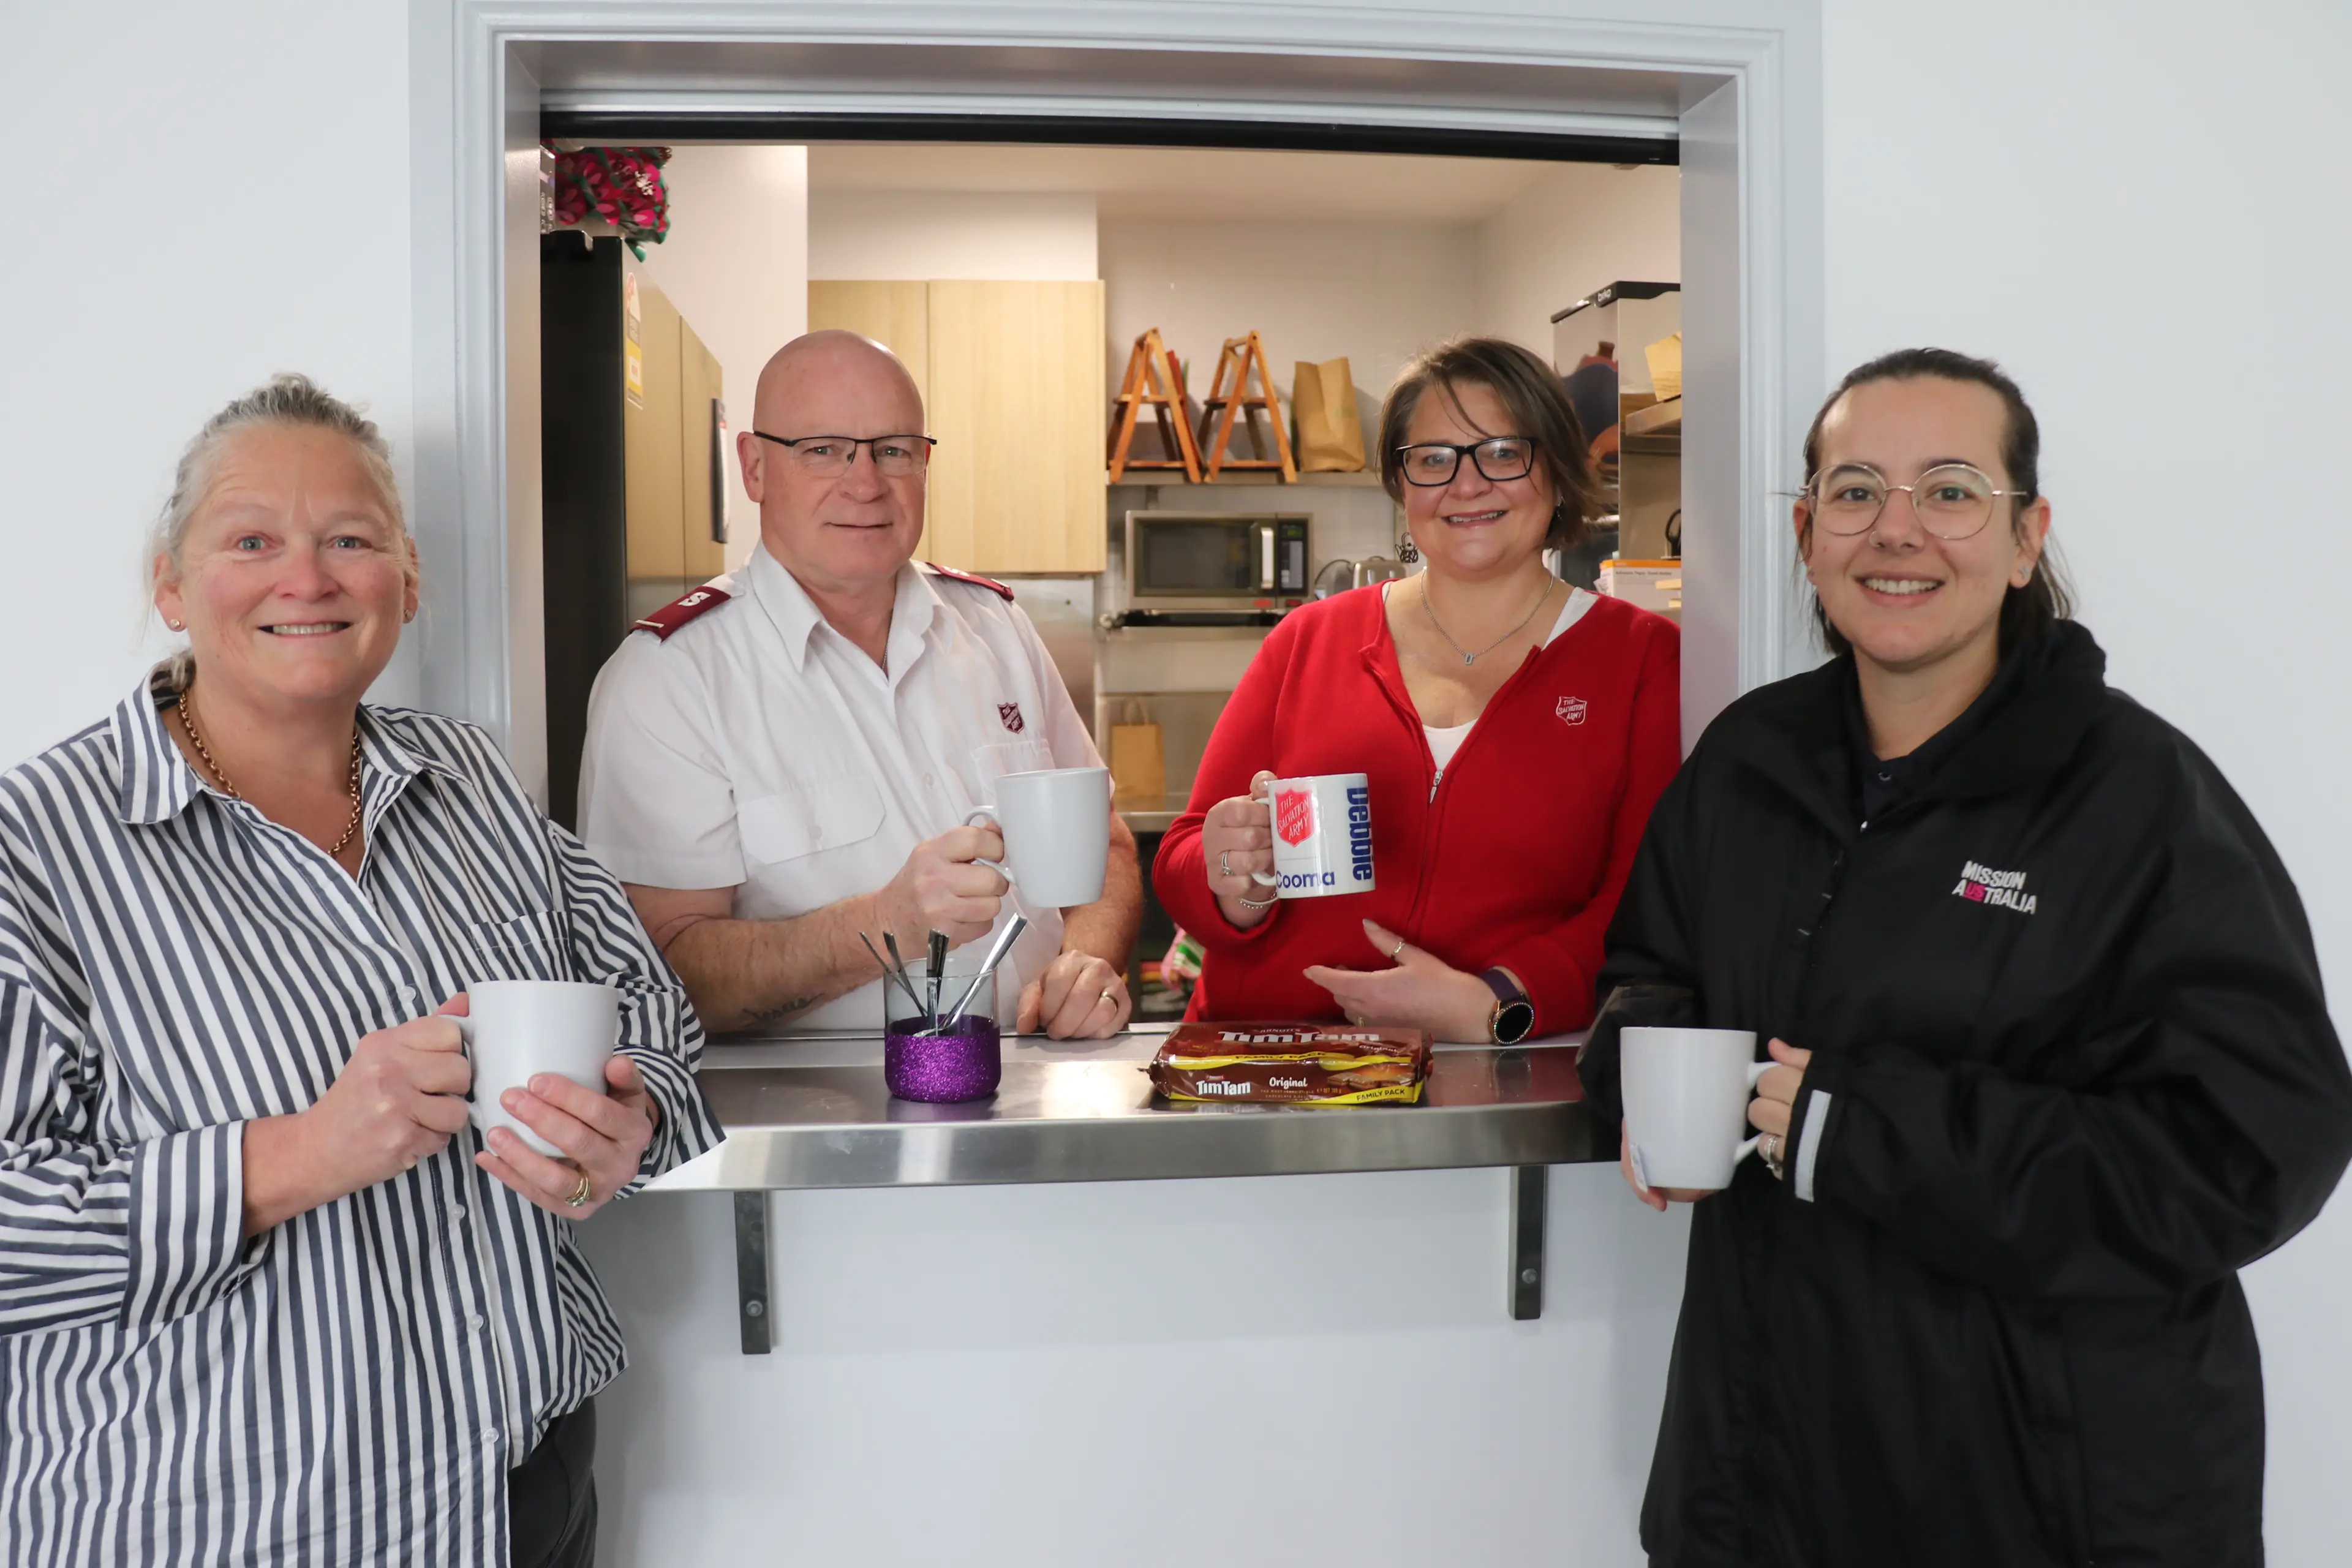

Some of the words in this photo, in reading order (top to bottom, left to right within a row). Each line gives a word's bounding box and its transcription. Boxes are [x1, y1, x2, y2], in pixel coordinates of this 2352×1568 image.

[1278, 797, 1310, 834] SALVATION
[1280, 794, 1294, 813] THE
[1288, 814, 1310, 841] ARMY
[1961, 860, 2027, 889] MISSION
[1951, 879, 2037, 914] AUSTRALIA
[1269, 1077, 1308, 1090] Original
[1356, 1091, 1383, 1101] FAMILY
